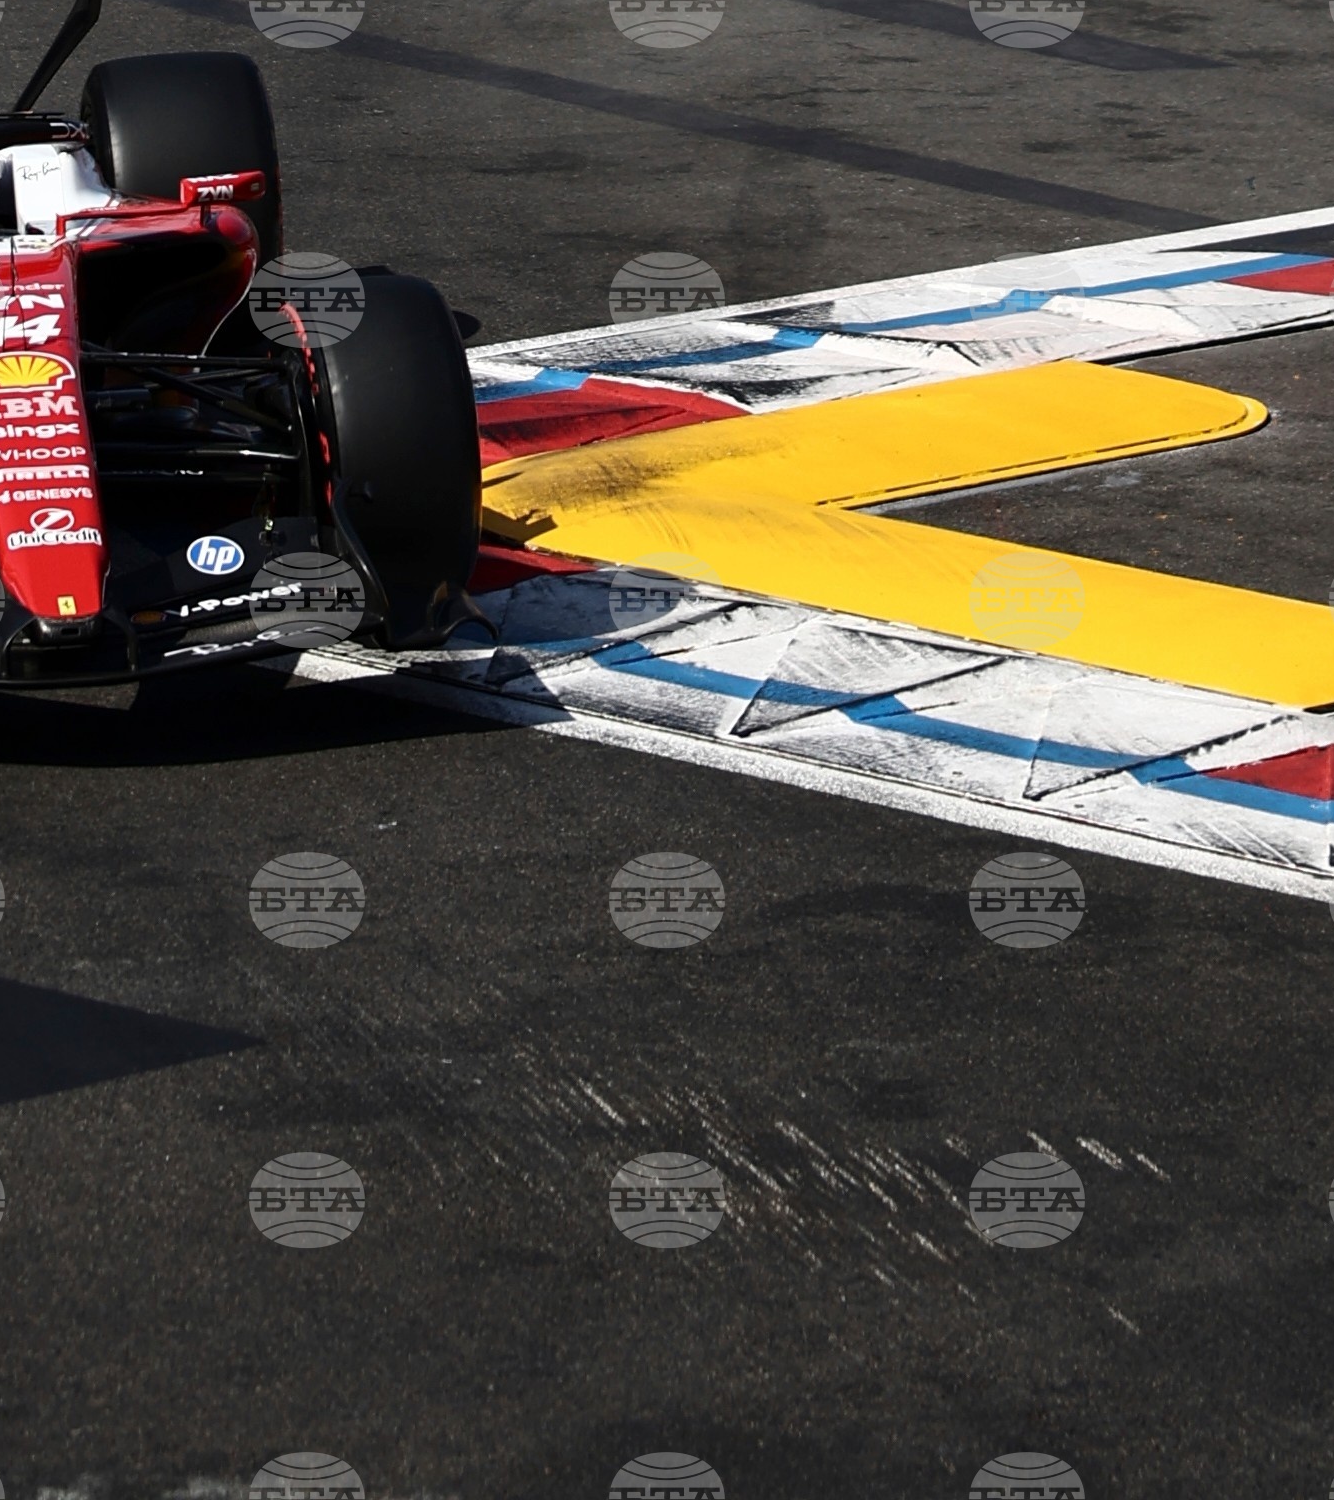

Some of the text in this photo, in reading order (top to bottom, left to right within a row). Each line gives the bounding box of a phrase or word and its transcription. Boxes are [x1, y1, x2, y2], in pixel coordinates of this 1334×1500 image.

[197, 184, 234, 202] ZYN
[13, 485, 94, 501] GENESYS
[6, 528, 103, 550] UniCredit
[197, 536, 236, 573] hp
